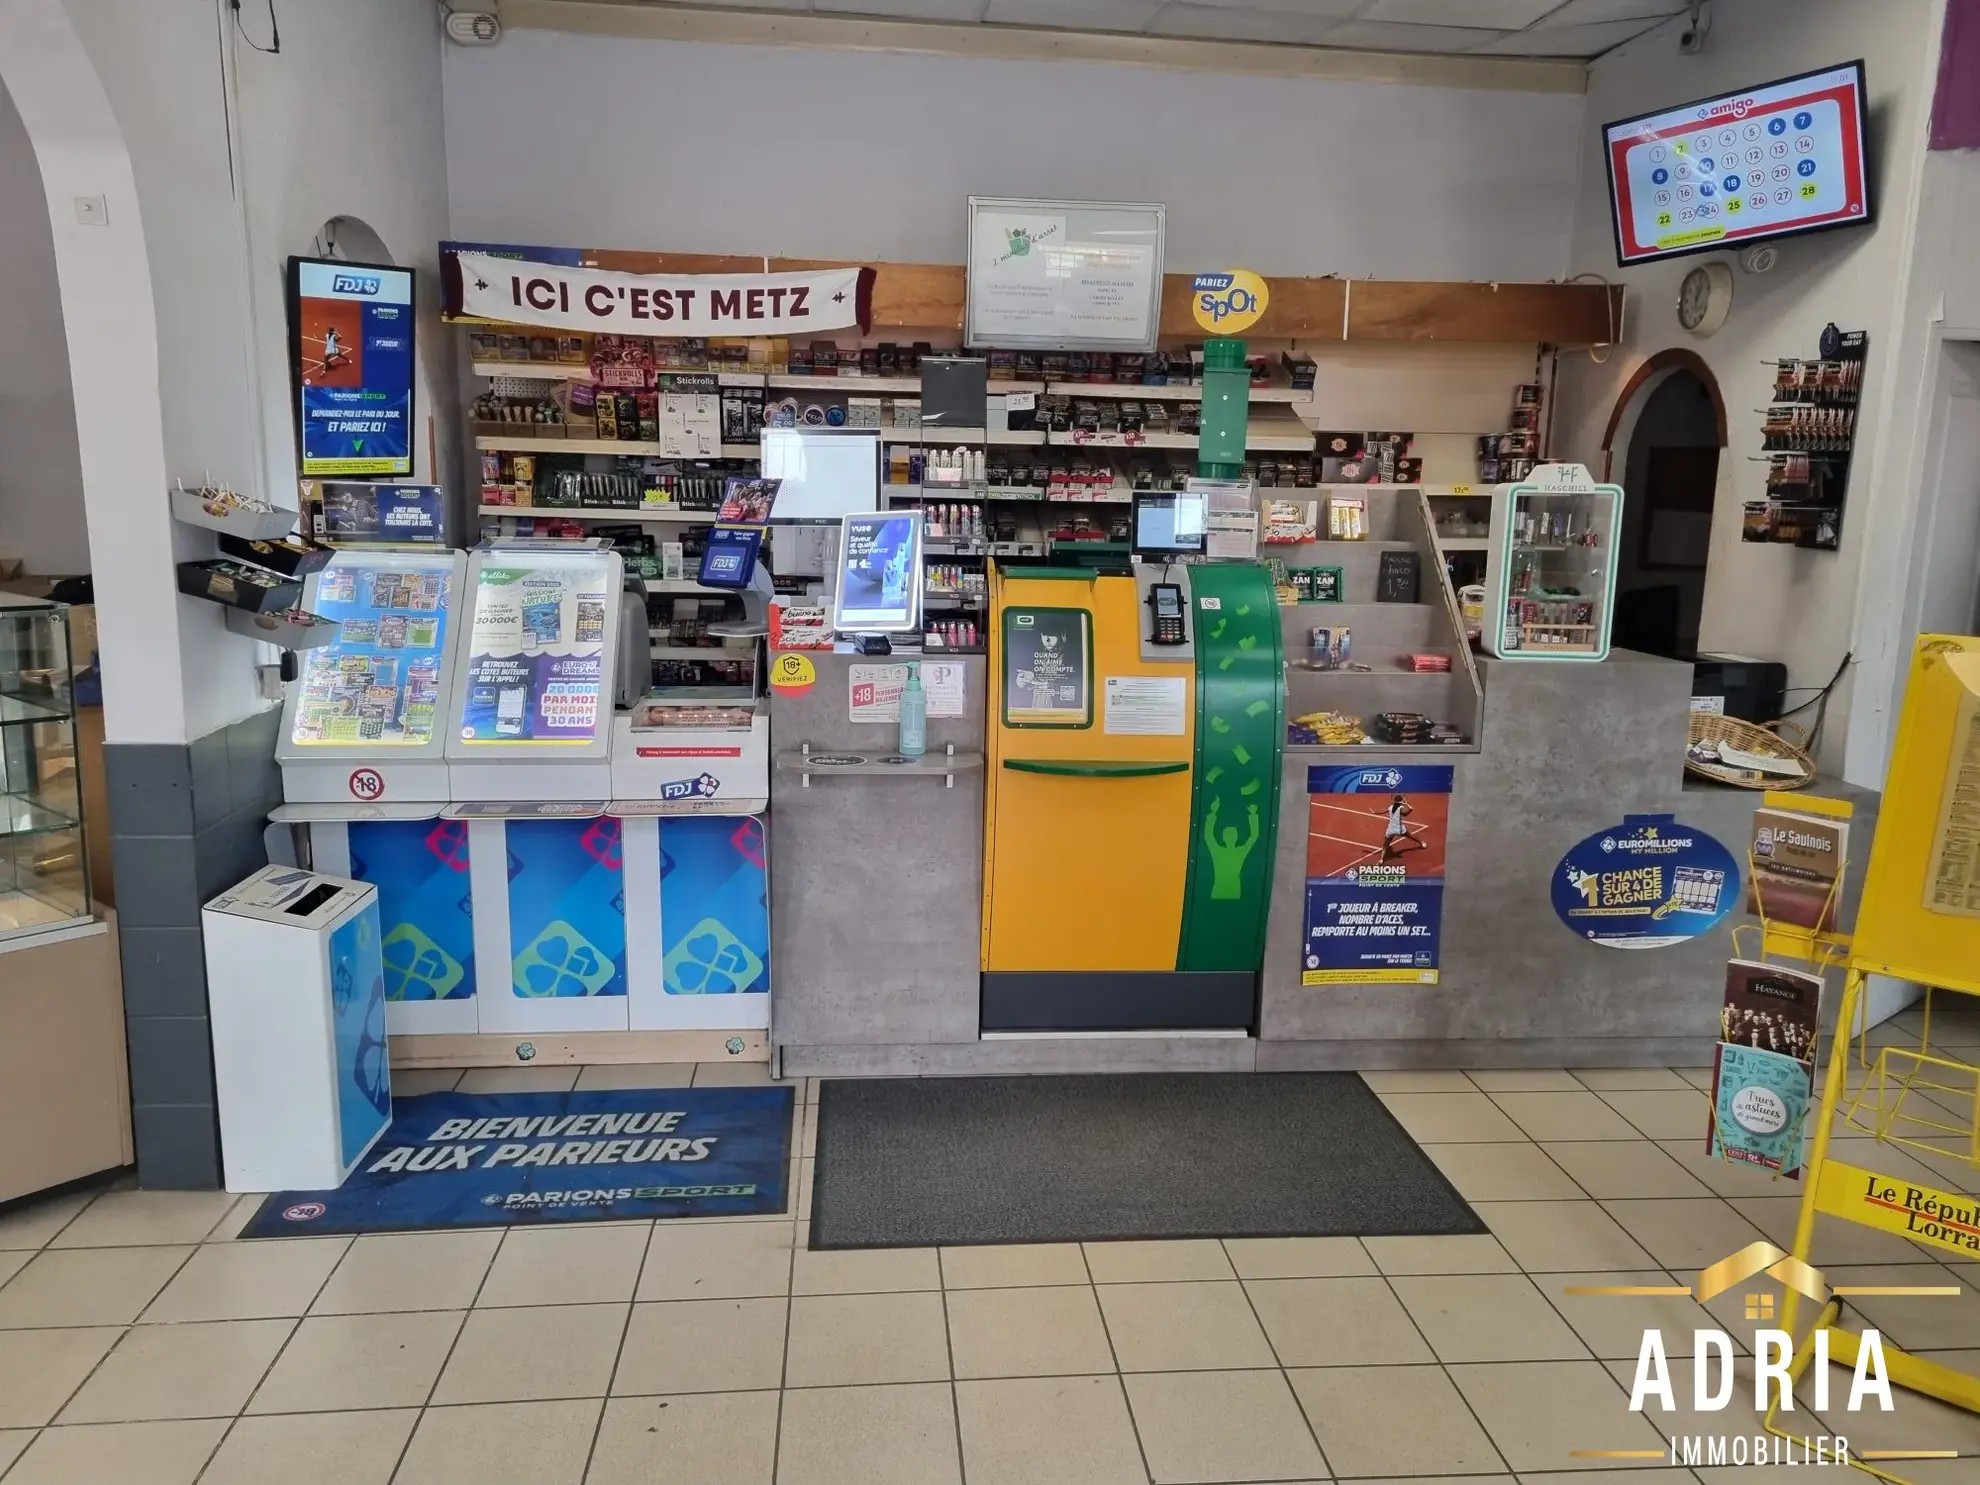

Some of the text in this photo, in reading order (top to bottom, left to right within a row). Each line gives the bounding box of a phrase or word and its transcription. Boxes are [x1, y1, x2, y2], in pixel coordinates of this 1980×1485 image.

[1711, 98, 1753, 116] amigo
[1726, 156, 1734, 165] 11
[1749, 151, 1759, 160] 12
[1774, 145, 1785, 154] 13
[1799, 139, 1811, 149] 14
[1657, 193, 1668, 202] 15
[1680, 188, 1690, 198] 16
[1726, 178, 1737, 188] 18
[1750, 173, 1762, 183] 19
[1774, 168, 1787, 178] 20
[1801, 162, 1812, 172] 21
[1659, 215, 1671, 224] 22
[1681, 210, 1693, 220] 23
[1728, 201, 1740, 211] 25
[1752, 196, 1765, 206] 26
[1776, 191, 1789, 201] 27
[1802, 185, 1815, 196] 28
[335, 276, 363, 292] FDJ
[1194, 277, 1229, 288] PARIEZ
[511, 275, 810, 321] ICI C'EST METZ
[676, 376, 715, 386] Stickrolls
[328, 422, 339, 433] ET
[340, 422, 370, 433] PARIEZ
[370, 422, 381, 433] ICI
[713, 558, 729, 568] FDJ
[1292, 576, 1311, 585] ZAN
[1316, 576, 1335, 585] ZAN
[786, 660, 801, 669] 18+
[549, 684, 565, 693] 20
[854, 687, 871, 703] +18
[544, 695, 568, 704] PAR
[550, 716, 593, 725] 30 ANS
[1362, 774, 1382, 783] FDJ
[665, 782, 692, 797] FDJ
[1618, 838, 1693, 849] EUROMILLIONS
[1773, 827, 1786, 842] Le
[1788, 830, 1832, 852] Saulnois
[1359, 865, 1406, 875] PARIONS
[1581, 866, 1662, 907] 1 CHANCE
[1603, 878, 1662, 895] SUR 4 DE
[1603, 889, 1662, 906] GAGNER
[1338, 903, 1372, 914] JOUEUR
[1379, 903, 1418, 915] BREAKER,
[1338, 915, 1404, 926] NOMBRE D'ACES,
[1311, 926, 1354, 937] REMPORTE
[1355, 926, 1369, 936] AU
[1369, 926, 1397, 936] MOINS
[1398, 926, 1411, 936] UN
[1755, 983, 1797, 1000] HAYANGE
[1747, 1090, 1775, 1107] Trucs
[1745, 1103, 1782, 1119] astuces
[427, 1111, 687, 1142] BIENVENUE
[366, 1137, 718, 1174] AUX PARIEURS
[504, 1185, 753, 1204] PARIONS SPORT
[1864, 1176, 1896, 1204] Le
[502, 1202, 544, 1211] POINT
[570, 1199, 614, 1208] VENTE
